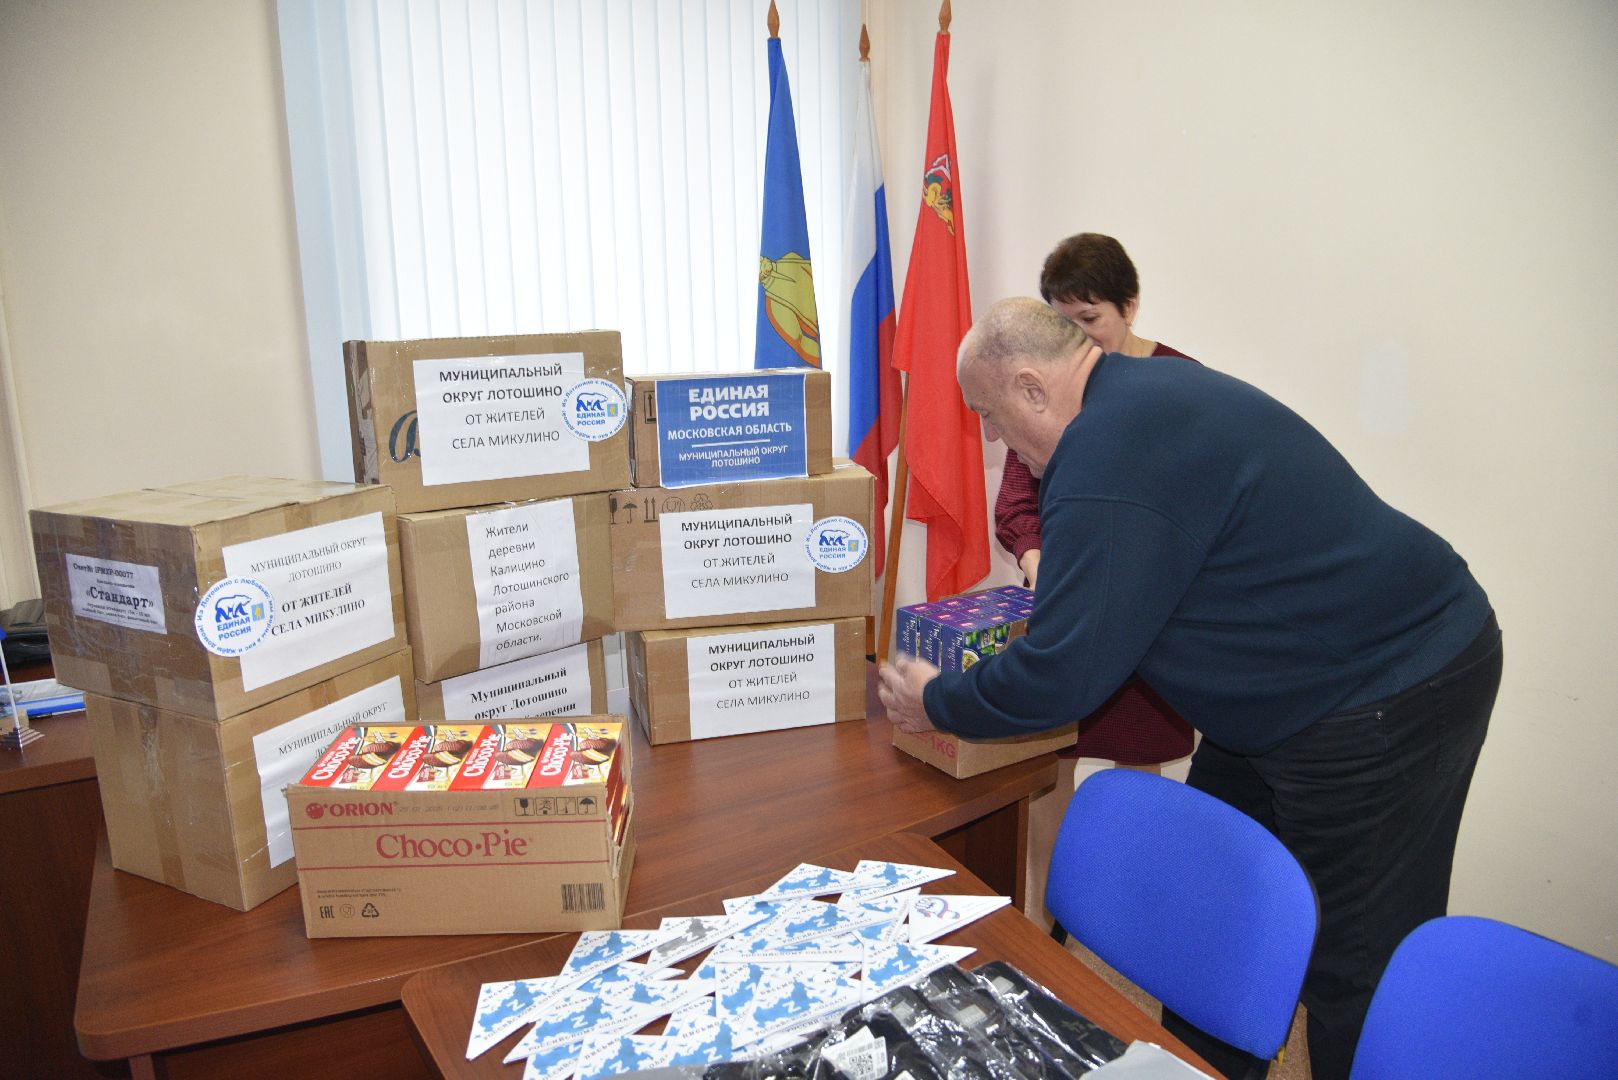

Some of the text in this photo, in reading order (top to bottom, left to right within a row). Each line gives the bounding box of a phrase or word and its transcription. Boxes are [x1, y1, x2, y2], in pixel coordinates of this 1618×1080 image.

[440, 363, 562, 382] МУНИЦИПАЛЬНЫЙ
[443, 385, 563, 404] ОКРУГ ЛОТОШИНО
[688, 384, 769, 404] ЕДИНАЯ
[465, 407, 545, 425] ОТ ЖИТЕЛЕЙ
[690, 401, 770, 421] РОССИЯ
[452, 430, 560, 450] СЕЛА МИКУЛИНО
[668, 422, 793, 441] МОСКОВСКАЯ ОБЛАСТЬ
[679, 445, 789, 461] МУНИЦИПАЛЬНЫЙ ОКРУГ
[711, 457, 760, 468] ЛОТОШИНО
[485, 523, 529, 538] Жители
[681, 513, 793, 531] МУНИЦИПАЛЬНЫЙ
[488, 541, 536, 560] деревни
[684, 533, 792, 550] ОКРУГ ЛОТОШИНО
[250, 537, 367, 574] МУНИЦИПАЛЬНЫЙ ОКРУГ
[703, 552, 775, 568] ОТ ЖИТЕЛЕЙ
[289, 561, 342, 583] ЛОТОШИНО
[490, 559, 546, 577] Калицино
[493, 572, 570, 596] Лотошинского
[691, 573, 789, 589] СЕЛА МИКУЛИНО
[86, 586, 154, 610] «Стандарт»
[282, 583, 352, 613] ОТ ЖИТЕЛЕЙ
[495, 599, 535, 617] района
[217, 617, 251, 631] ЕДИНАЯ
[271, 599, 365, 637] СЕЛА МИКУЛИНО
[496, 609, 562, 634] Московской
[218, 626, 252, 641] РОССИЯ
[496, 633, 542, 651] области.
[708, 633, 815, 654] МУНИЦИПАЛЬНЫЙ
[710, 653, 814, 672] ОКРУГ ЛОТОШИНО
[470, 667, 567, 704] Муниципальный
[728, 671, 797, 689] ОТ ЖИТЕЛЕЙ
[510, 687, 568, 710] Лотошино
[716, 690, 810, 710] СЕЛА МИКУЛИНО
[278, 702, 387, 756] МУНИЦИПАЛЬНЫЙ ОКРУГ
[329, 802, 394, 817] ORION
